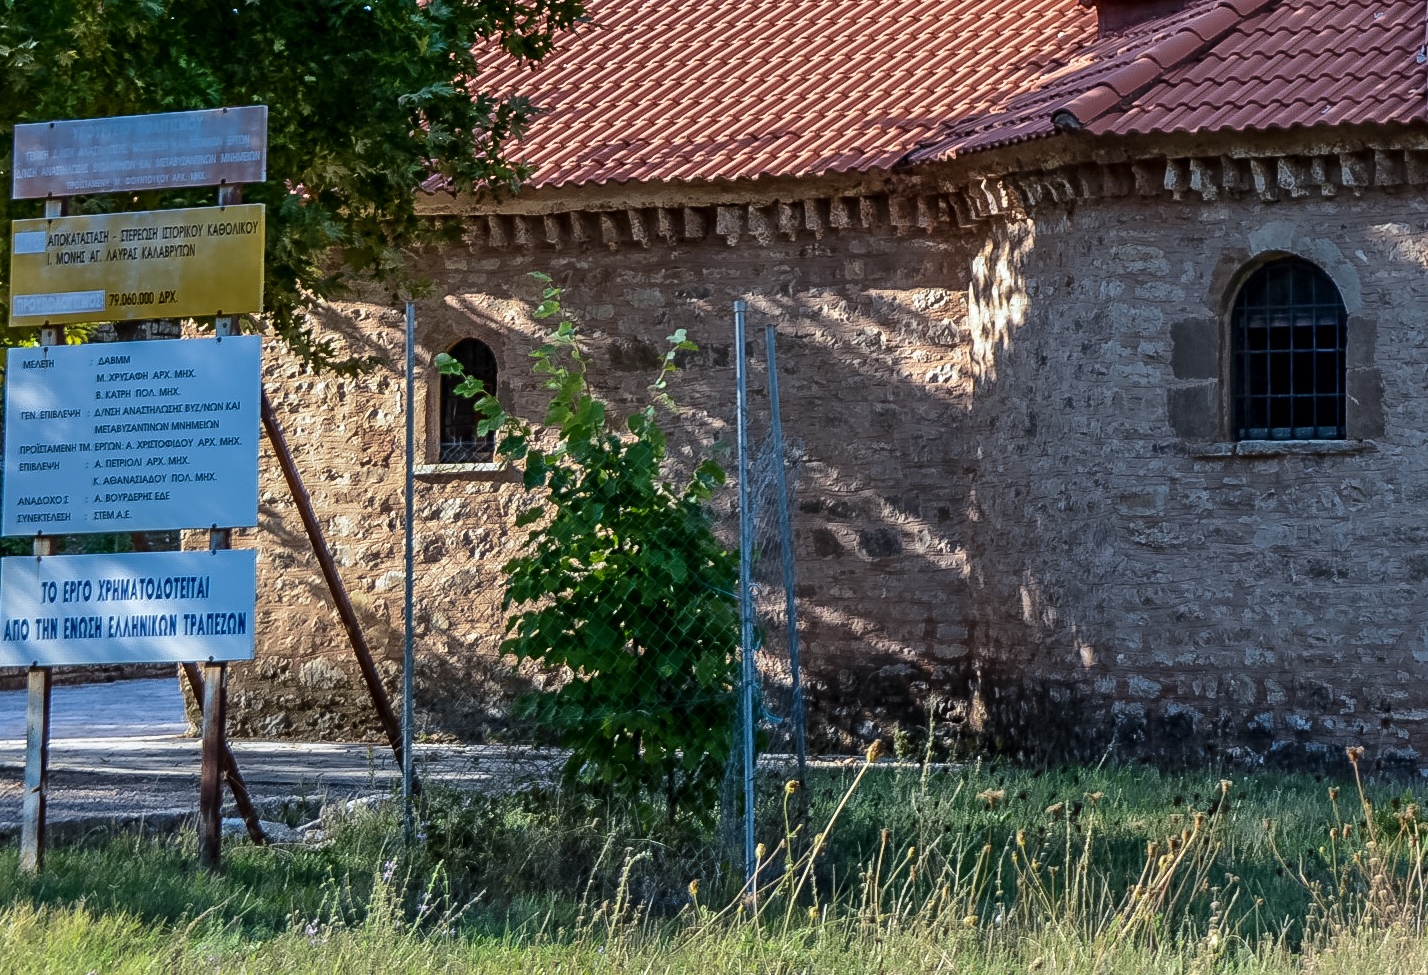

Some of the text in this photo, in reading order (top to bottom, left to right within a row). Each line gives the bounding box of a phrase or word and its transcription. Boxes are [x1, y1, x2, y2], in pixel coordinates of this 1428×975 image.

[47, 230, 110, 247] ΑΠΟΚΑΤΑΣΤΑΣΗ
[120, 226, 159, 242] ΣΤΕΡΕΩΣΗ
[162, 224, 204, 240] ΙΣΤΟΡΙΚΟΥ
[207, 220, 259, 237] ΚΑΘΟΛΙΚΟΥ
[56, 250, 86, 265] ΜΟΝΗΣ
[89, 249, 103, 263] ΑΓ.
[106, 247, 138, 262] ΛΑΥΡΑΣ
[141, 243, 196, 260] ΚΑΛΑΒΡΥΤΩΝ
[108, 291, 155, 306] 79.060.000
[158, 290, 179, 304] ΔΡΧ.
[22, 359, 55, 369] ΜΕΛΕΤΗ
[98, 355, 131, 366] ΔΑΒΜΜ
[96, 368, 197, 382] Μ. ΧΡΥΣΑΦΗ ΑΡΧ. ΜΗΧ.
[105, 389, 132, 399] ΚΑΤΡΗ
[136, 388, 156, 398] ΠΟΛ.
[159, 387, 181, 397] ΜΗΧ.
[21, 411, 38, 420] ΓΕΝ.
[40, 409, 81, 419] ΕΠΙΒΛΕΨΗ
[94, 407, 121, 417] Δ/ΝΣΗ
[122, 403, 184, 416] ΑΝΑΣΤΗΛΩΣΗΣ
[184, 401, 224, 413] ΒΥΖ/ΝΩΝ
[225, 401, 241, 411] ΚΑΙ
[95, 420, 220, 434] ΜΕΤΑΒΥΖΑΝΤΙΝΩΝ ΜΝΗΜΕΙΩΝ
[125, 441, 135, 450] Α.
[136, 438, 194, 450] ΧΡΙΣΤΟΦΙΔΟΥ
[197, 437, 218, 447] ΑΡΧ.
[219, 436, 243, 446] ΜΗΧ.
[19, 461, 60, 472] ΕΠΙΒΛΕΨΗ
[94, 459, 103, 469] Α.
[146, 456, 166, 466] ΑΡΧ.
[168, 455, 191, 466] ΜΗΧ.
[93, 472, 217, 486] Κ. ΑΘΑΝΑΣΙΑΔΟΥ ΠΟΛ. ΜΗΧ.
[94, 493, 103, 503] Α.
[105, 491, 153, 503] ΒΟΥΡΔΕΡΗΣ
[154, 491, 171, 501] ΕΔΕ
[16, 512, 71, 523] ΣΥΝΕΚΤΕΛΕΣΗ
[93, 510, 115, 521] ΣΤΕΜ
[41, 575, 210, 604] ΤΟ ΕΡΓΟ ΧΡΗΜΑΤΟΔΟΤΕΙΤΑΙ
[3, 611, 247, 642] ΑΠΟ ΤΗΝ ΕΝΩΣΗ ΕΛΛΗΝΙΚΩΝ ΤΡΑΠΕΖΩΝ
